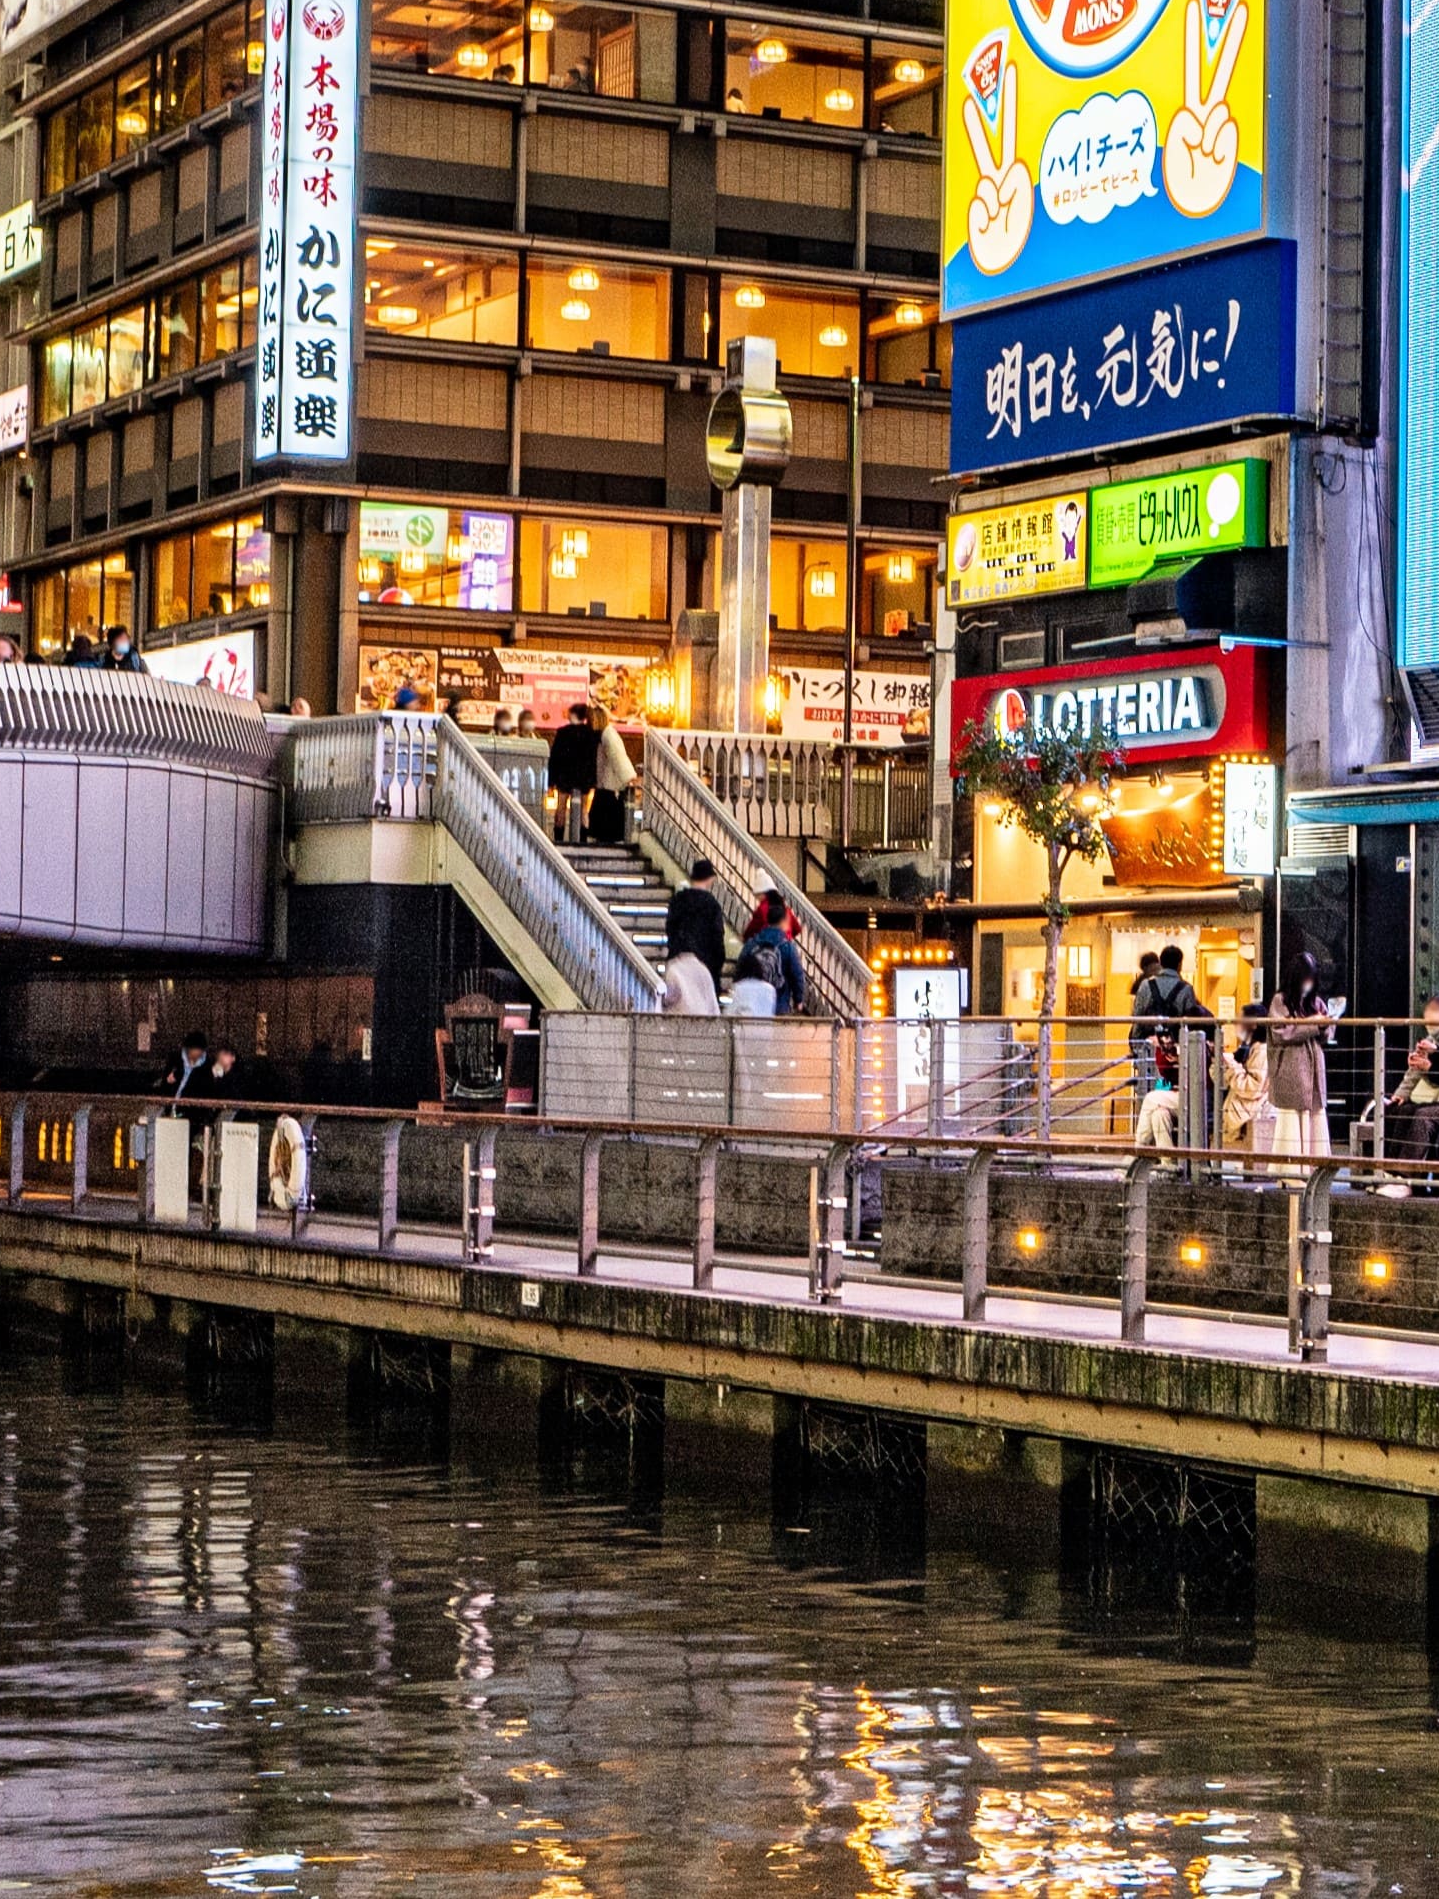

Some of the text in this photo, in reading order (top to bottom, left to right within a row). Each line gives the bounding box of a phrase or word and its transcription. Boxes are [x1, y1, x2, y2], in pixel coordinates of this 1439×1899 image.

[293, 53, 342, 441] 本場の味 かに道楽
[1138, 483, 1201, 547] ピタットハウス
[1033, 676, 1202, 744] LOTTERIA
